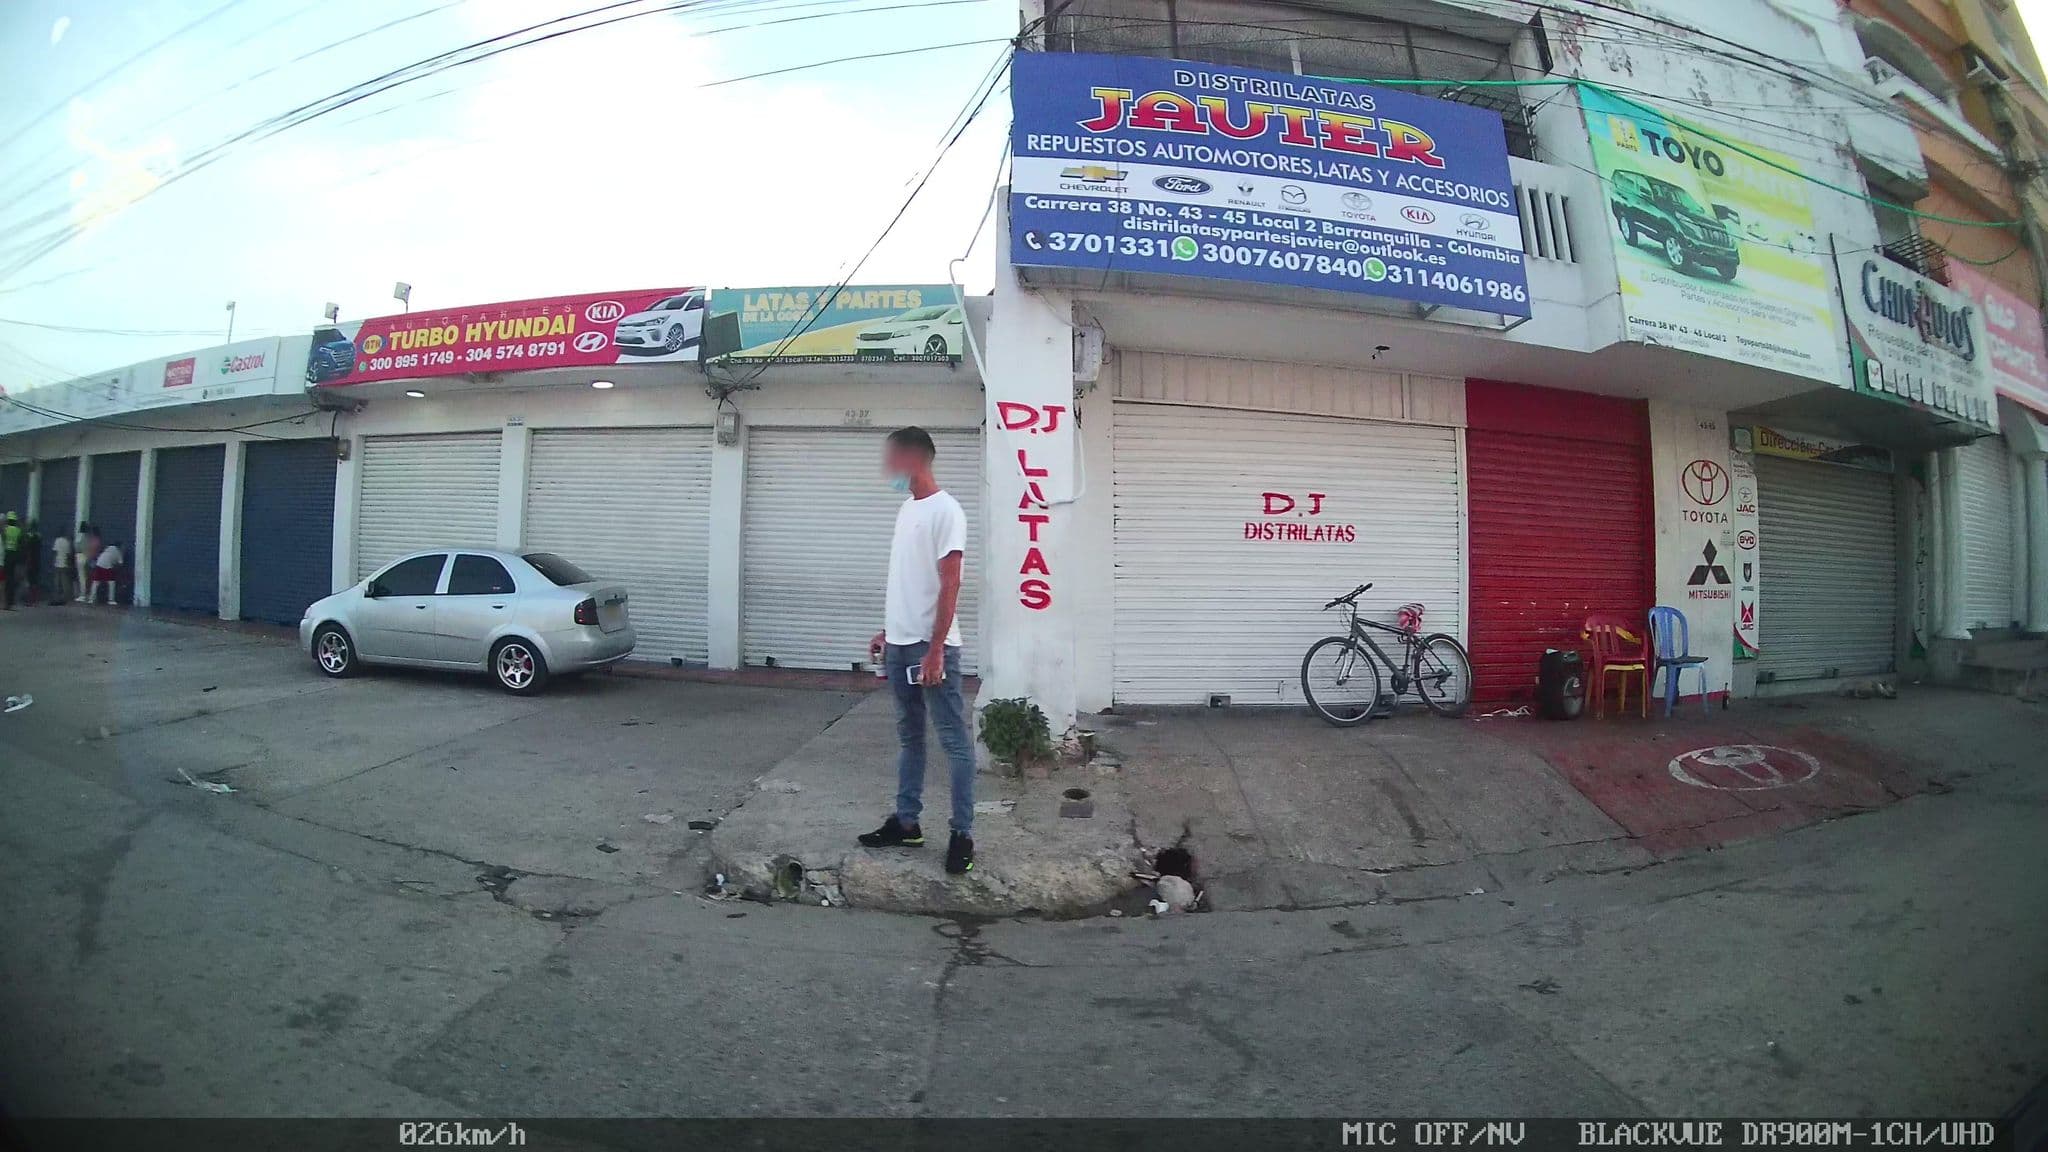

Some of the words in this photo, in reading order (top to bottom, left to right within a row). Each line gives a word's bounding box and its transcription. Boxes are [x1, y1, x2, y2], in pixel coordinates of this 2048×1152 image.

[1174, 70, 1376, 111] DISTRILATAS
[1641, 128, 1725, 177] TOYO
[1028, 134, 1146, 157] REPUESTOS
[1377, 170, 1389, 186] Y
[1396, 175, 1511, 208] ACCESORIOS
[1059, 183, 1129, 194] CHEVROLET
[1163, 175, 1202, 193] Ford
[1227, 198, 1266, 208] RENAULT
[1341, 210, 1377, 222] TOYOTA
[1407, 208, 1430, 222] KIA
[1025, 196, 1101, 212] Carrera
[1108, 200, 1132, 214] 38
[1138, 203, 1172, 218] No.
[1178, 206, 1203, 220] 43
[1222, 210, 1246, 225] 45
[1252, 213, 1300, 231] Local
[1305, 219, 1317, 233] 2
[1322, 219, 1431, 249] Barranquilla
[1447, 240, 1521, 265] Colombia
[1122, 215, 1447, 266] distrilatasypartesjavier@outlook.es
[1456, 229, 1496, 242] HYUNDAI
[1202, 242, 1362, 278] 3007607840
[1388, 264, 1526, 302] 3114061986
[743, 291, 809, 312] LATAS
[836, 289, 922, 310] PARTES
[591, 304, 618, 320] KIA
[389, 324, 459, 351] TURBO
[465, 313, 576, 343] HYUNDAI
[1628, 315, 1656, 328] Carrera
[1704, 330, 1721, 342] Local
[230, 351, 266, 373] Castrol
[370, 357, 392, 371] 300
[395, 354, 418, 368] 895
[422, 351, 454, 366] 1749
[465, 348, 492, 362] 304
[496, 344, 524, 359] 574
[528, 340, 566, 357] 8791
[1682, 510, 1729, 524] TOYOTA
[1736, 504, 1756, 513] JAC
[1017, 449, 1052, 610] LATAS
[1244, 522, 1356, 542] DISTRILATAS
[1688, 589, 1732, 600] MITSUBISHI
